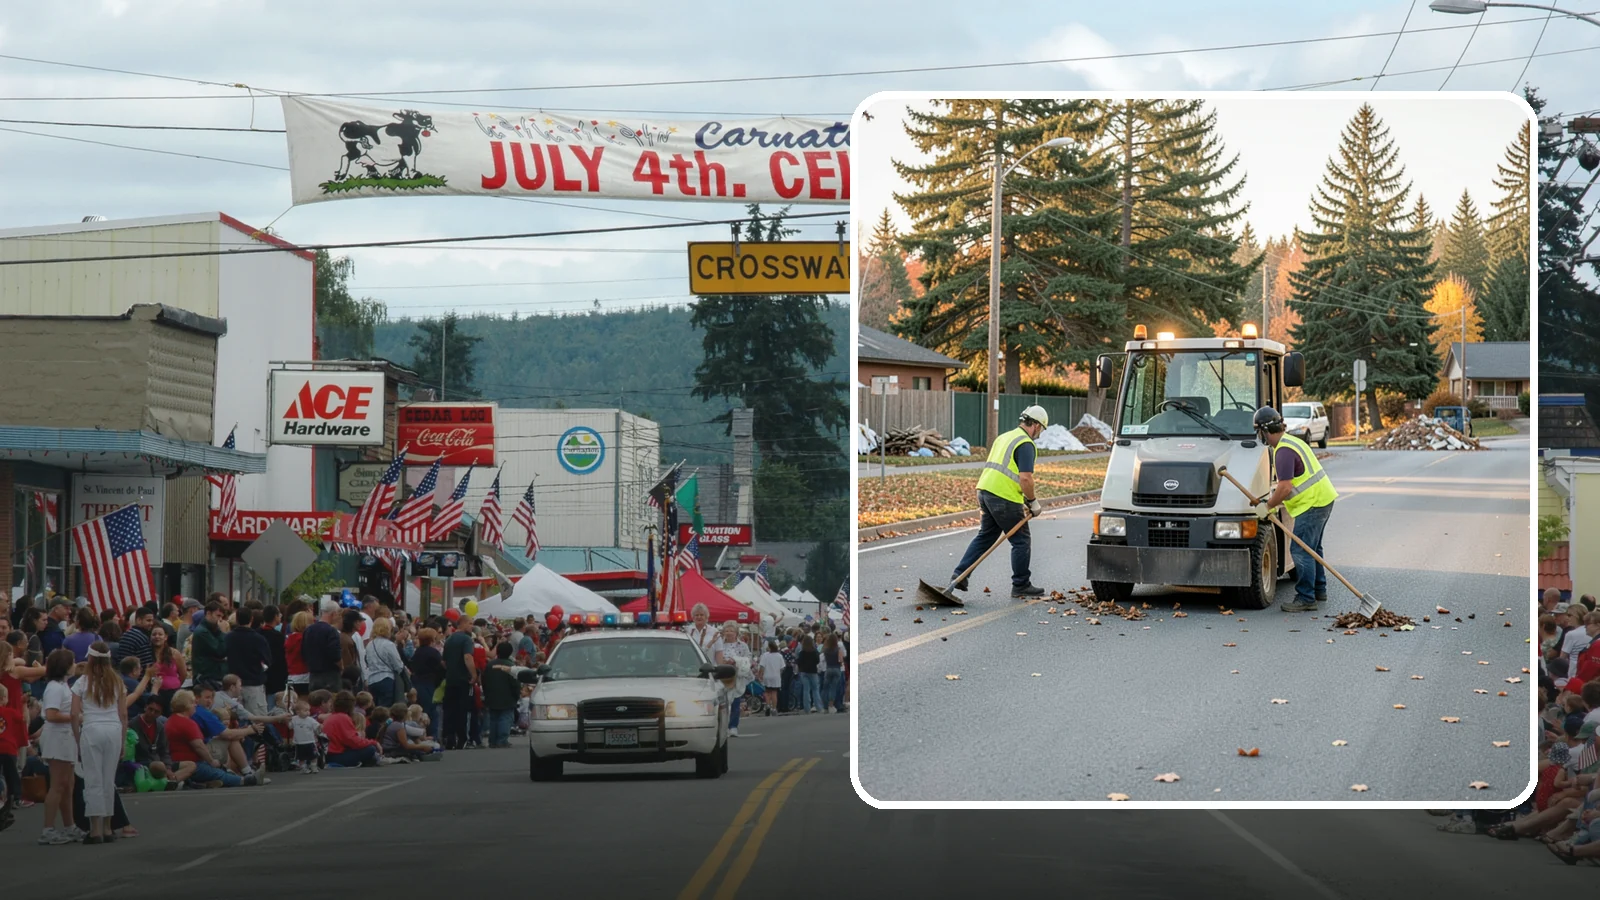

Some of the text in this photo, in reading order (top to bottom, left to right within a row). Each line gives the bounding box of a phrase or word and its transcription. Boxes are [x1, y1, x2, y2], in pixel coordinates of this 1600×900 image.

[481, 141, 605, 193] JULY
[632, 150, 746, 198] 4th.
[696, 254, 850, 280] CROSSWA
[282, 380, 374, 420] ACE
[405, 409, 453, 422] CEDAR
[283, 421, 371, 436] Hardware
[416, 428, 477, 447] Coca-Cola
[96, 485, 124, 495] Vincent
[126, 486, 136, 495] de
[138, 486, 155, 496] Paul
[688, 526, 742, 535] CRNATION
[699, 535, 730, 543] GLASS
